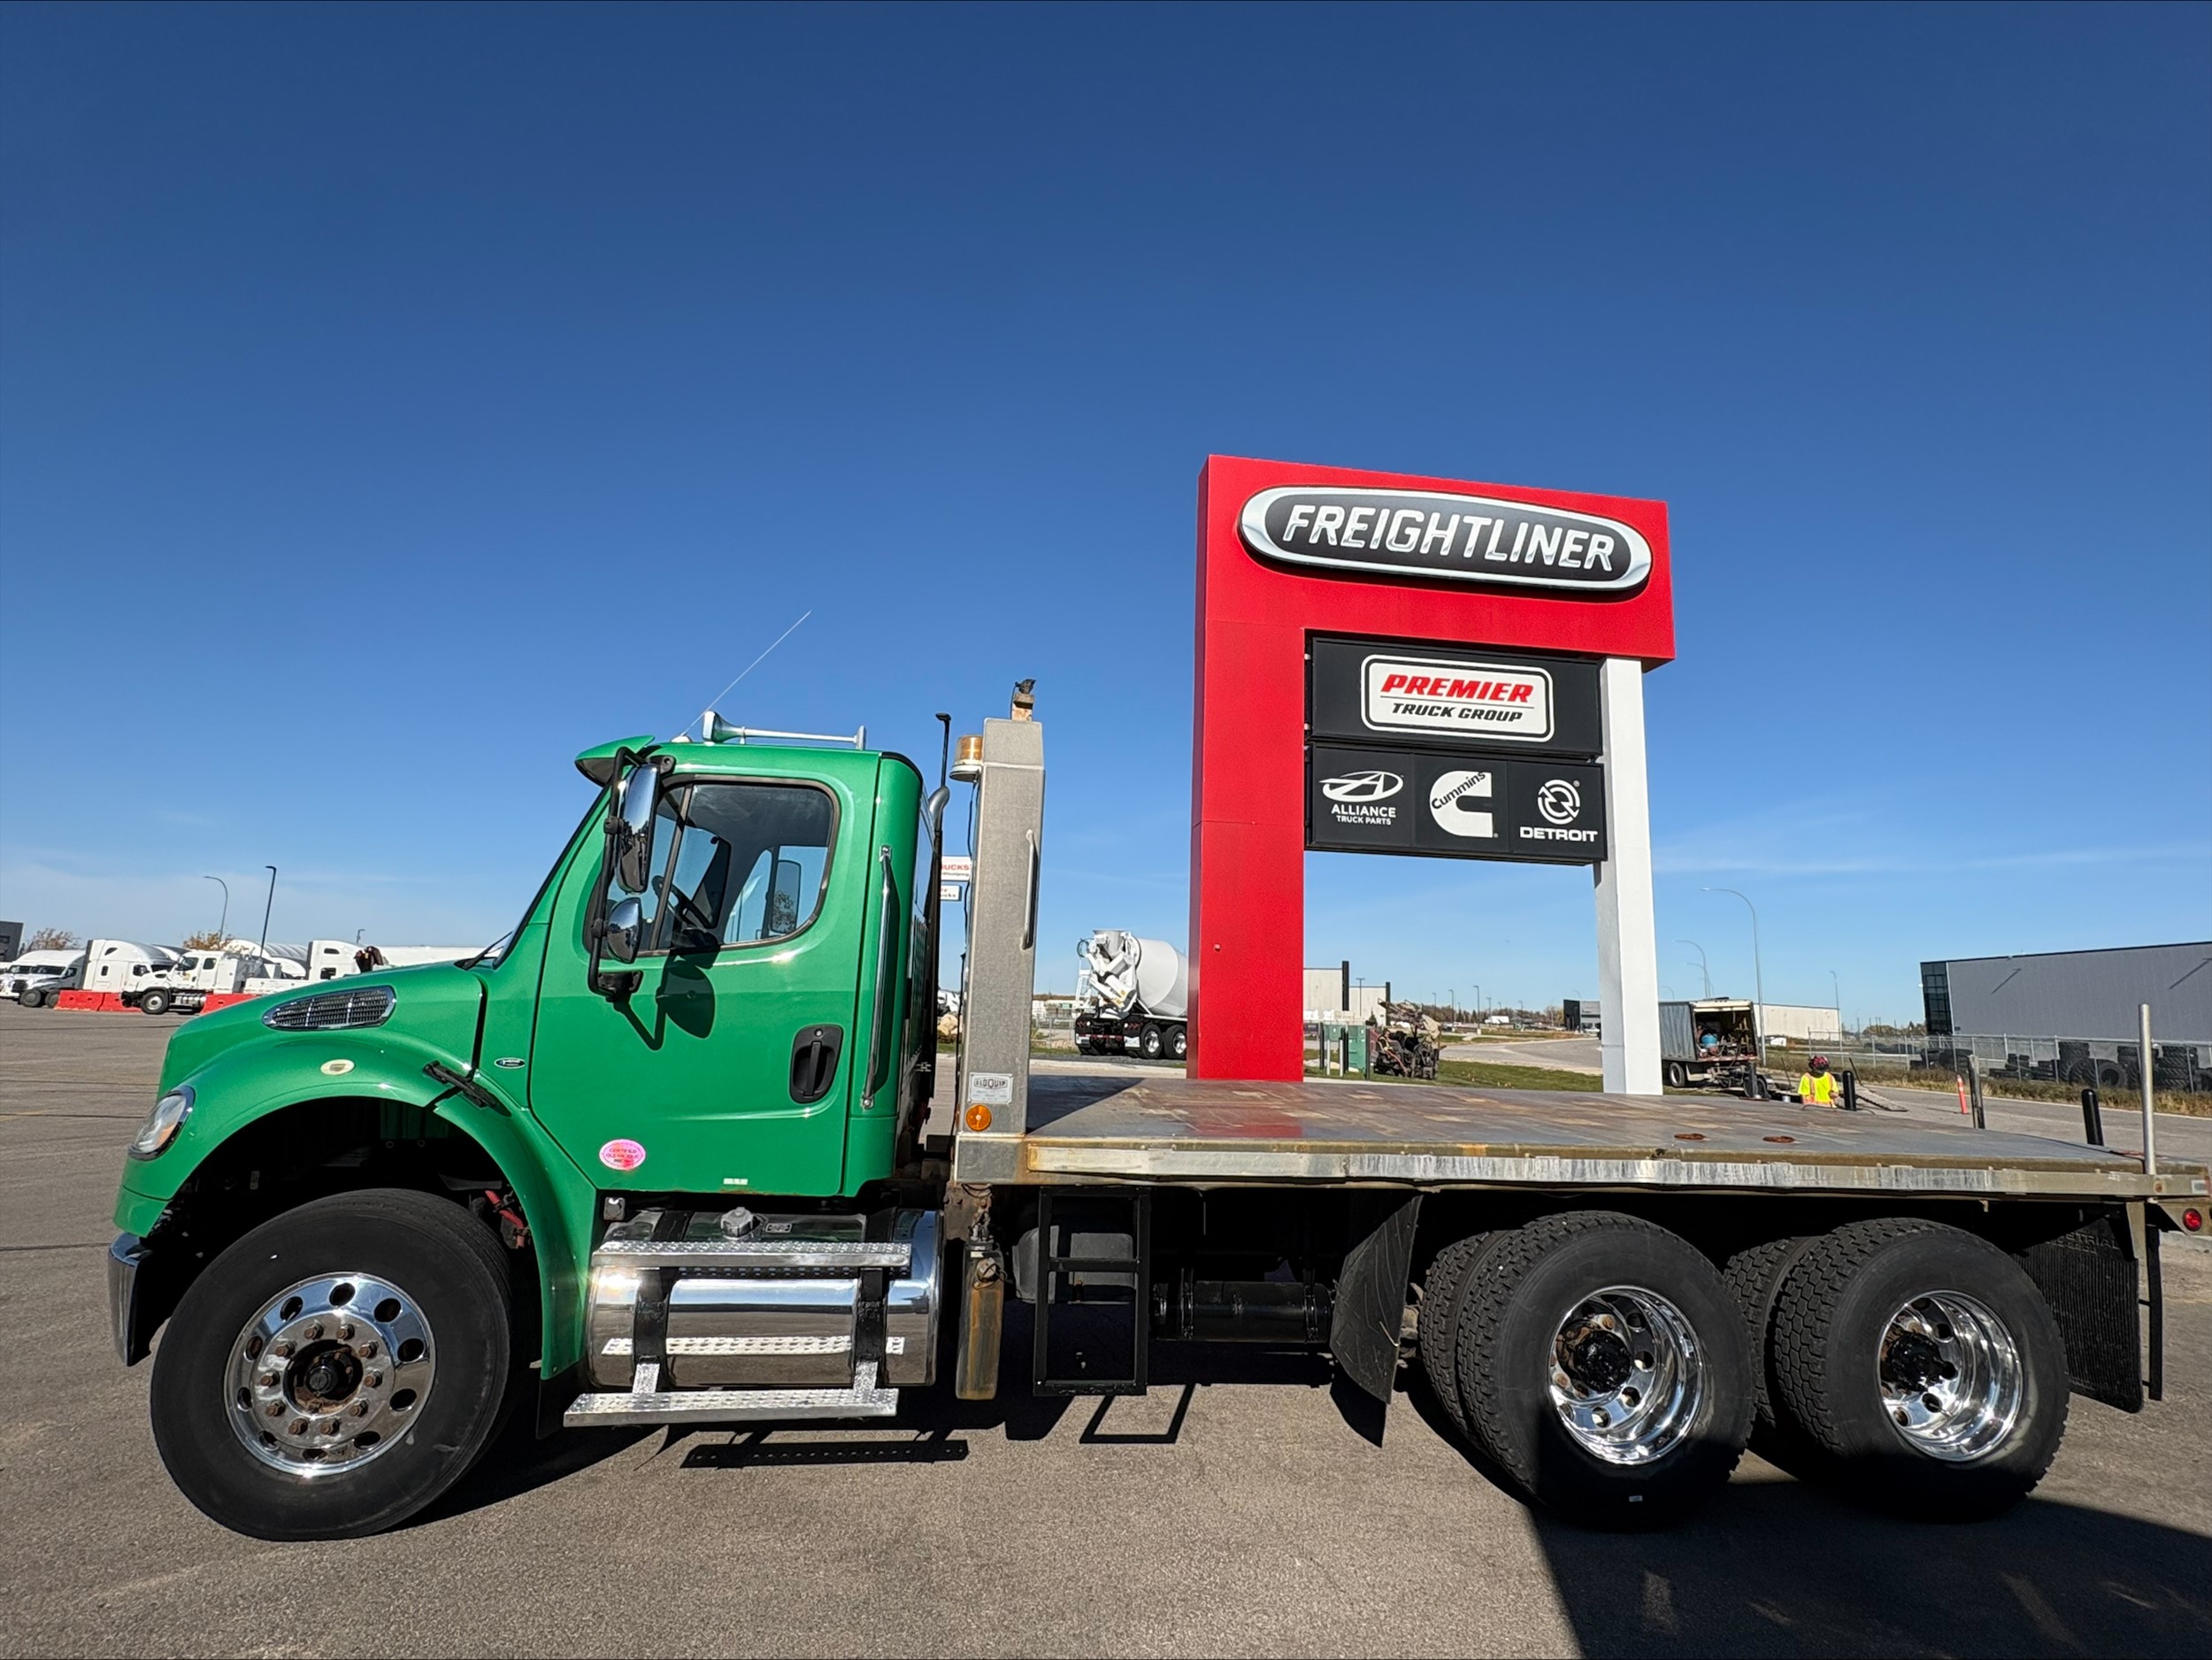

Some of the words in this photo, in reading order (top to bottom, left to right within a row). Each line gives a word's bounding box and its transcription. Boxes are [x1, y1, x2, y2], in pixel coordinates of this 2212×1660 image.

[1282, 504, 1615, 572] FREIGHTLINER
[1380, 673, 1534, 703] PREMIER
[1392, 703, 1456, 718] TRUCK
[1458, 707, 1523, 722] GROUP
[1431, 771, 1486, 810] Cummins
[1331, 803, 1396, 818] ALLIANCE
[1336, 814, 1363, 824] TRUCK
[1365, 817, 1392, 826] PARTS
[1519, 826, 1599, 842] DETROIT
